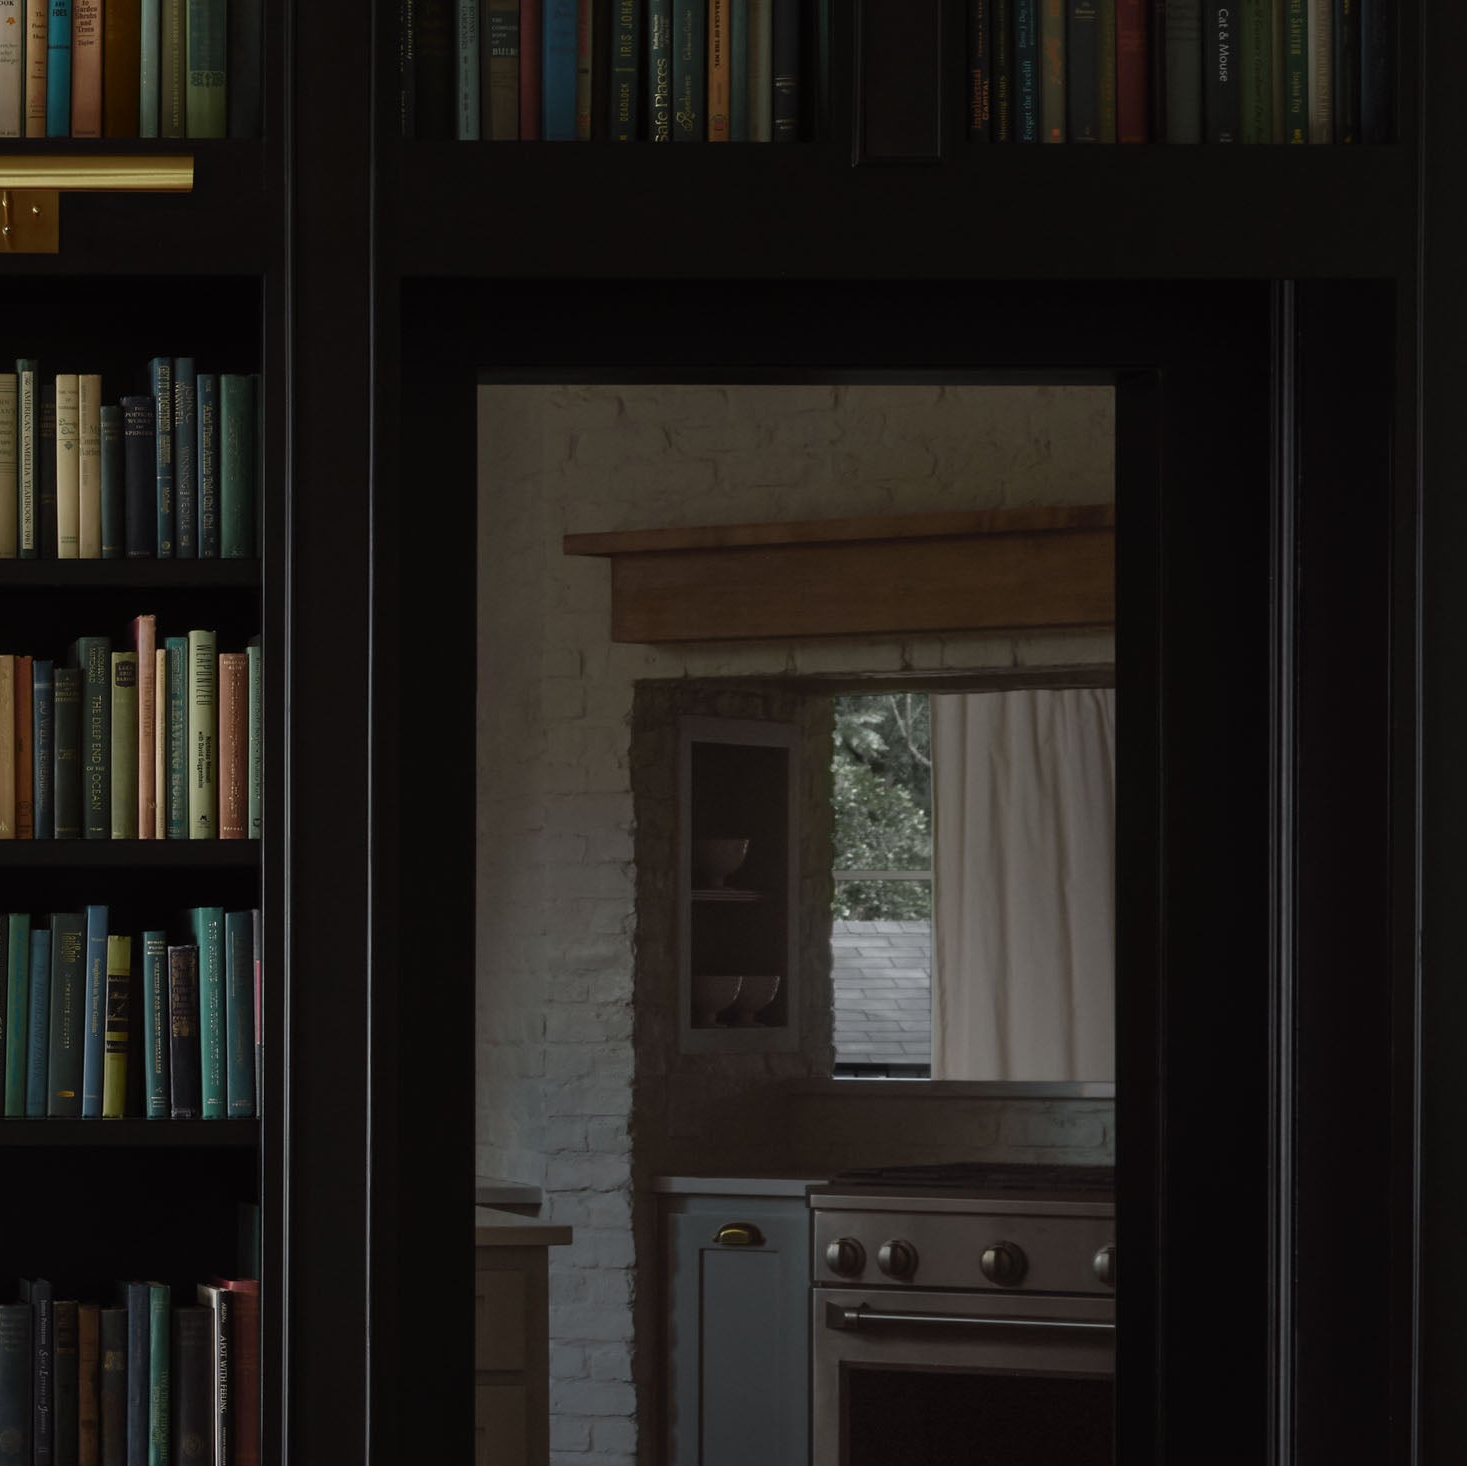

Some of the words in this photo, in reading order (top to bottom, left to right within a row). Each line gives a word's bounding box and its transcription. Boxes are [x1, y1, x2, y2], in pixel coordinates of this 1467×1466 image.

[1218, 8, 1229, 28] Cat
[1219, 31, 1229, 40] &
[1219, 44, 1229, 82] Mouse
[654, 59, 667, 107] Places
[92, 696, 101, 713] THE
[92, 743, 101, 762] END
[92, 774, 101, 810] OCEAN
